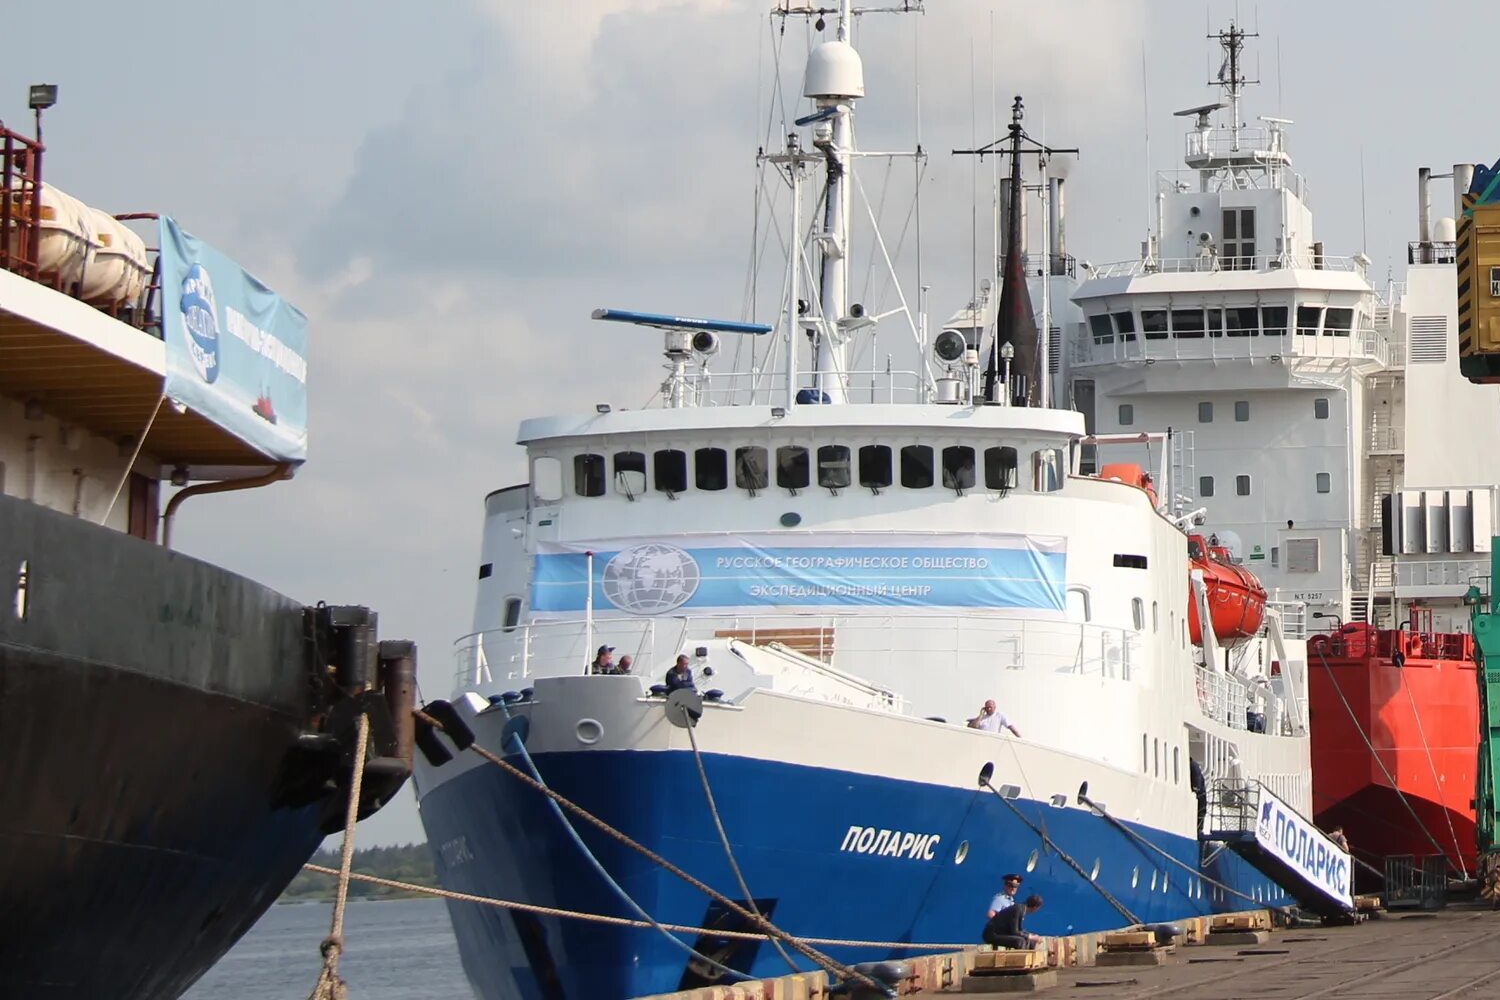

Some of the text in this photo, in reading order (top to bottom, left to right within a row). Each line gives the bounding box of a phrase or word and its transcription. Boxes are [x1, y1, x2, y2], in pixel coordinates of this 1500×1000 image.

[716, 556, 989, 570] РУССКОЕ ГЕОГРАФИЧЕСКОЕ ОБЩЕСТВО
[750, 582, 932, 599] ЭКСПЕДИЦИОННЫЙ ЦЕНТР
[840, 825, 941, 860] ПОЛАРИС
[1275, 808, 1347, 897] ПОЛАРИС
